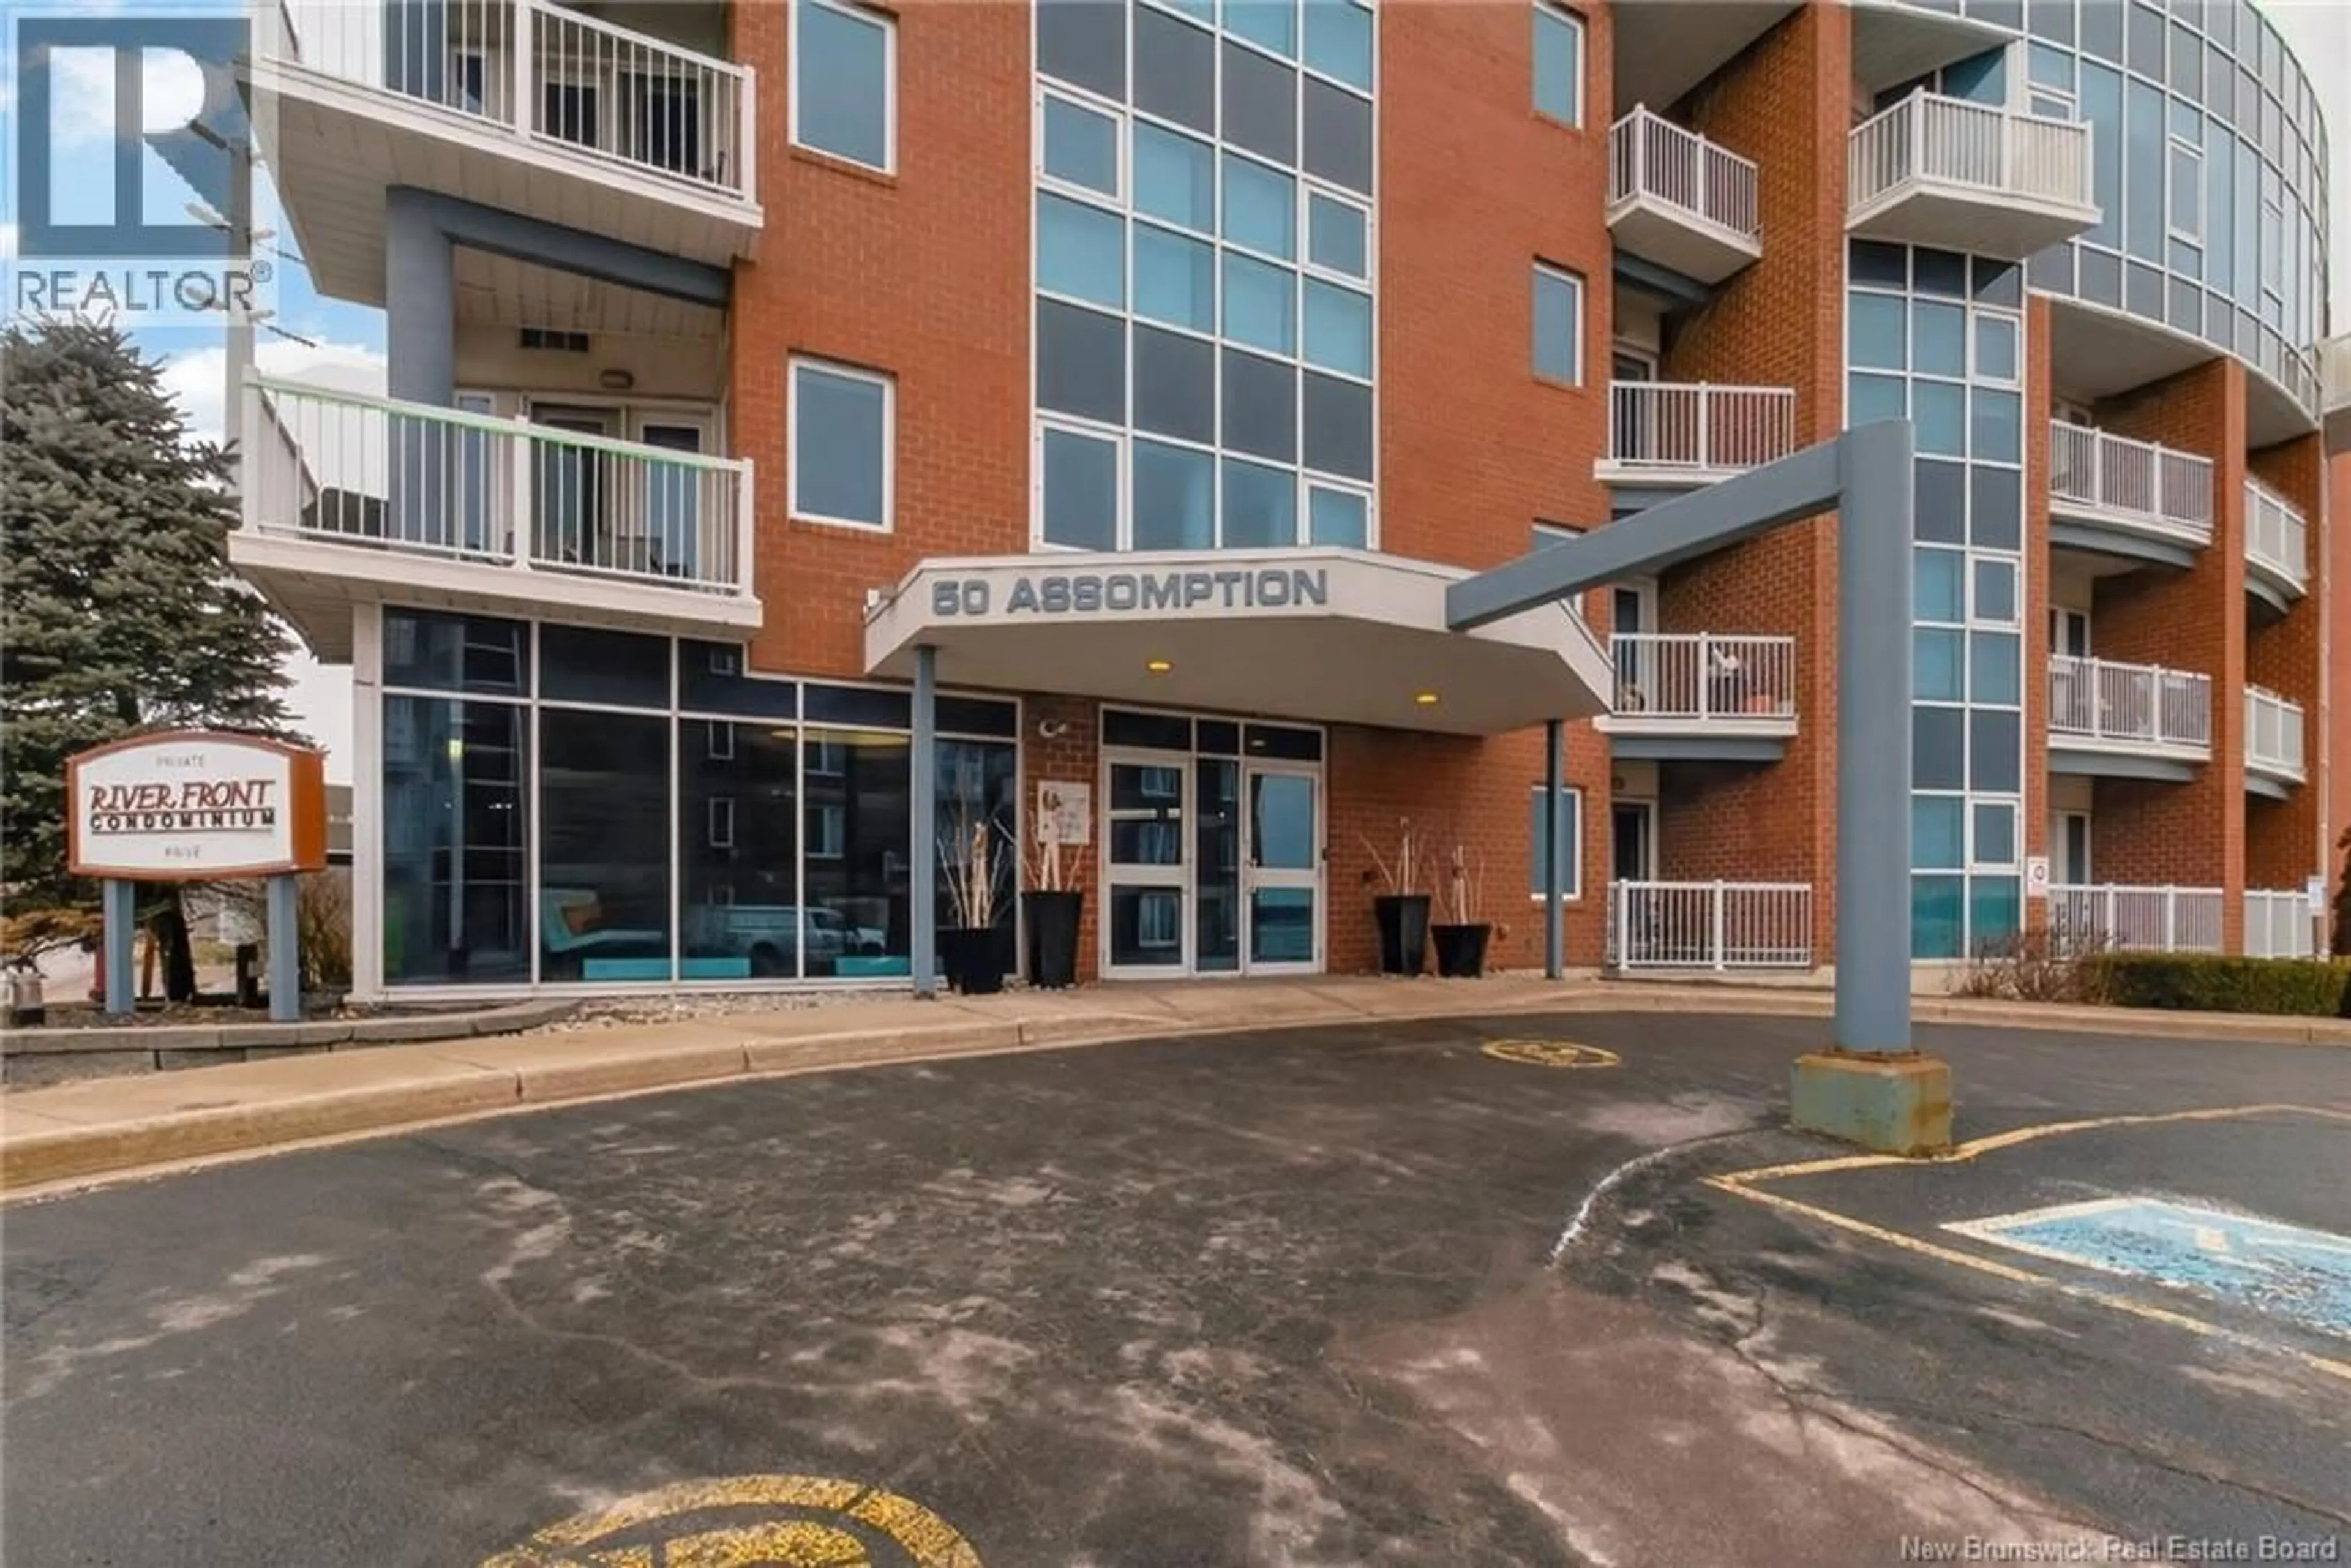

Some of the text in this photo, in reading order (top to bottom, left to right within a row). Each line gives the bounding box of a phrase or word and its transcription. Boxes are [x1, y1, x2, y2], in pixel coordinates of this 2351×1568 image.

[932, 569, 1328, 615] 50 ASSOMPTION
[90, 779, 276, 811] RIVER FRONT
[89, 811, 275, 830] CONDOMINIUM
